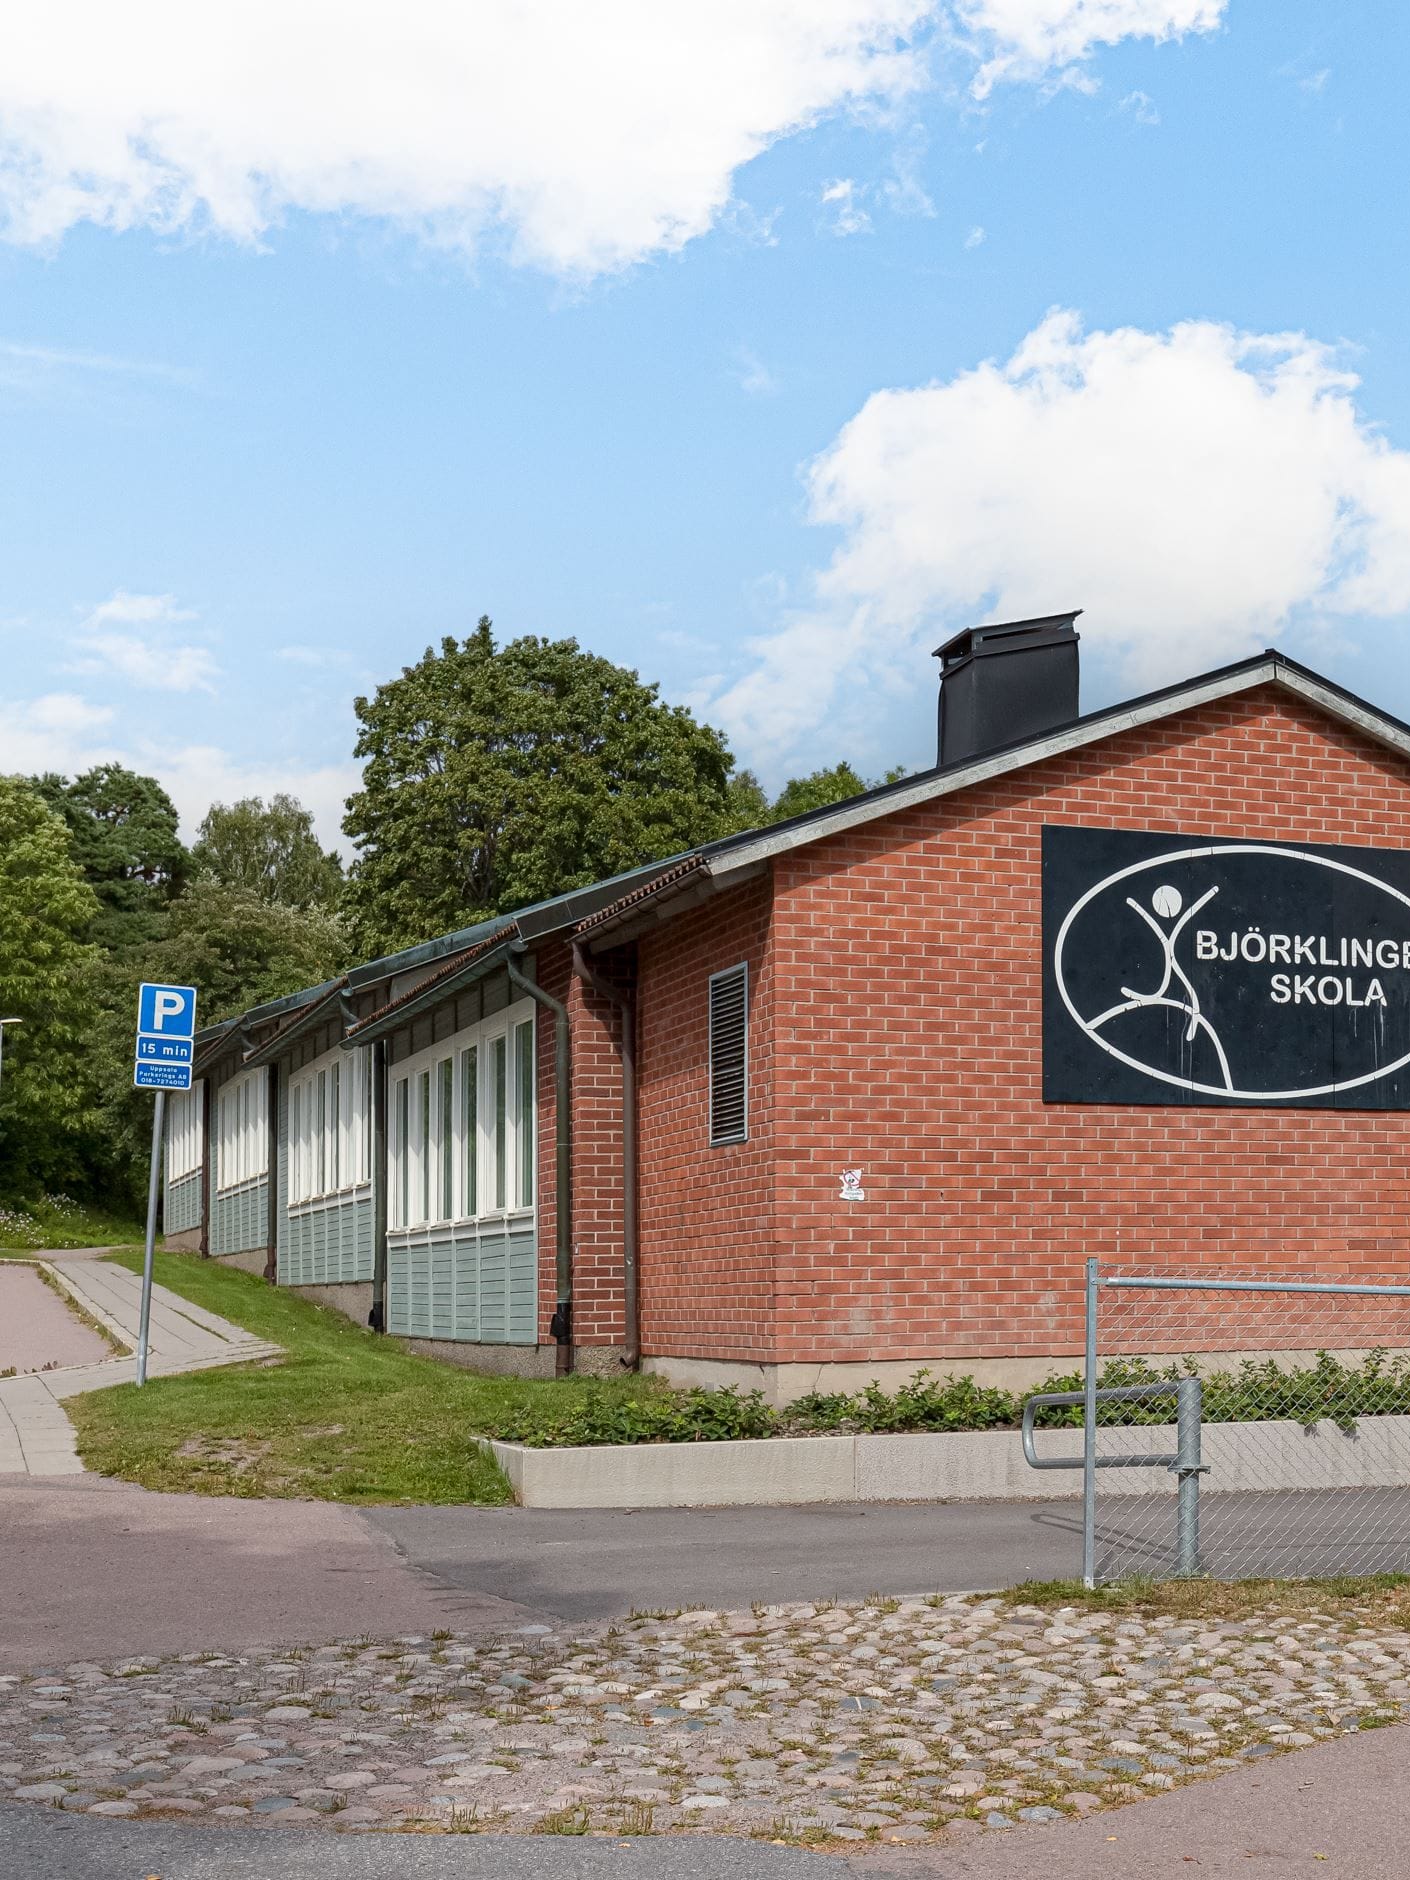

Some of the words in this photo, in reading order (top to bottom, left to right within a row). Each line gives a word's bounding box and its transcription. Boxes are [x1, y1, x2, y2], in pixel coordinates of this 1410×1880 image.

[1270, 974, 1388, 1007] SKOLA
[153, 990, 185, 1030] P
[142, 1042, 156, 1054] 15
[162, 1045, 188, 1057] min
[139, 1071, 176, 1079] Parkerings
[150, 1065, 178, 1073] Uppsala
